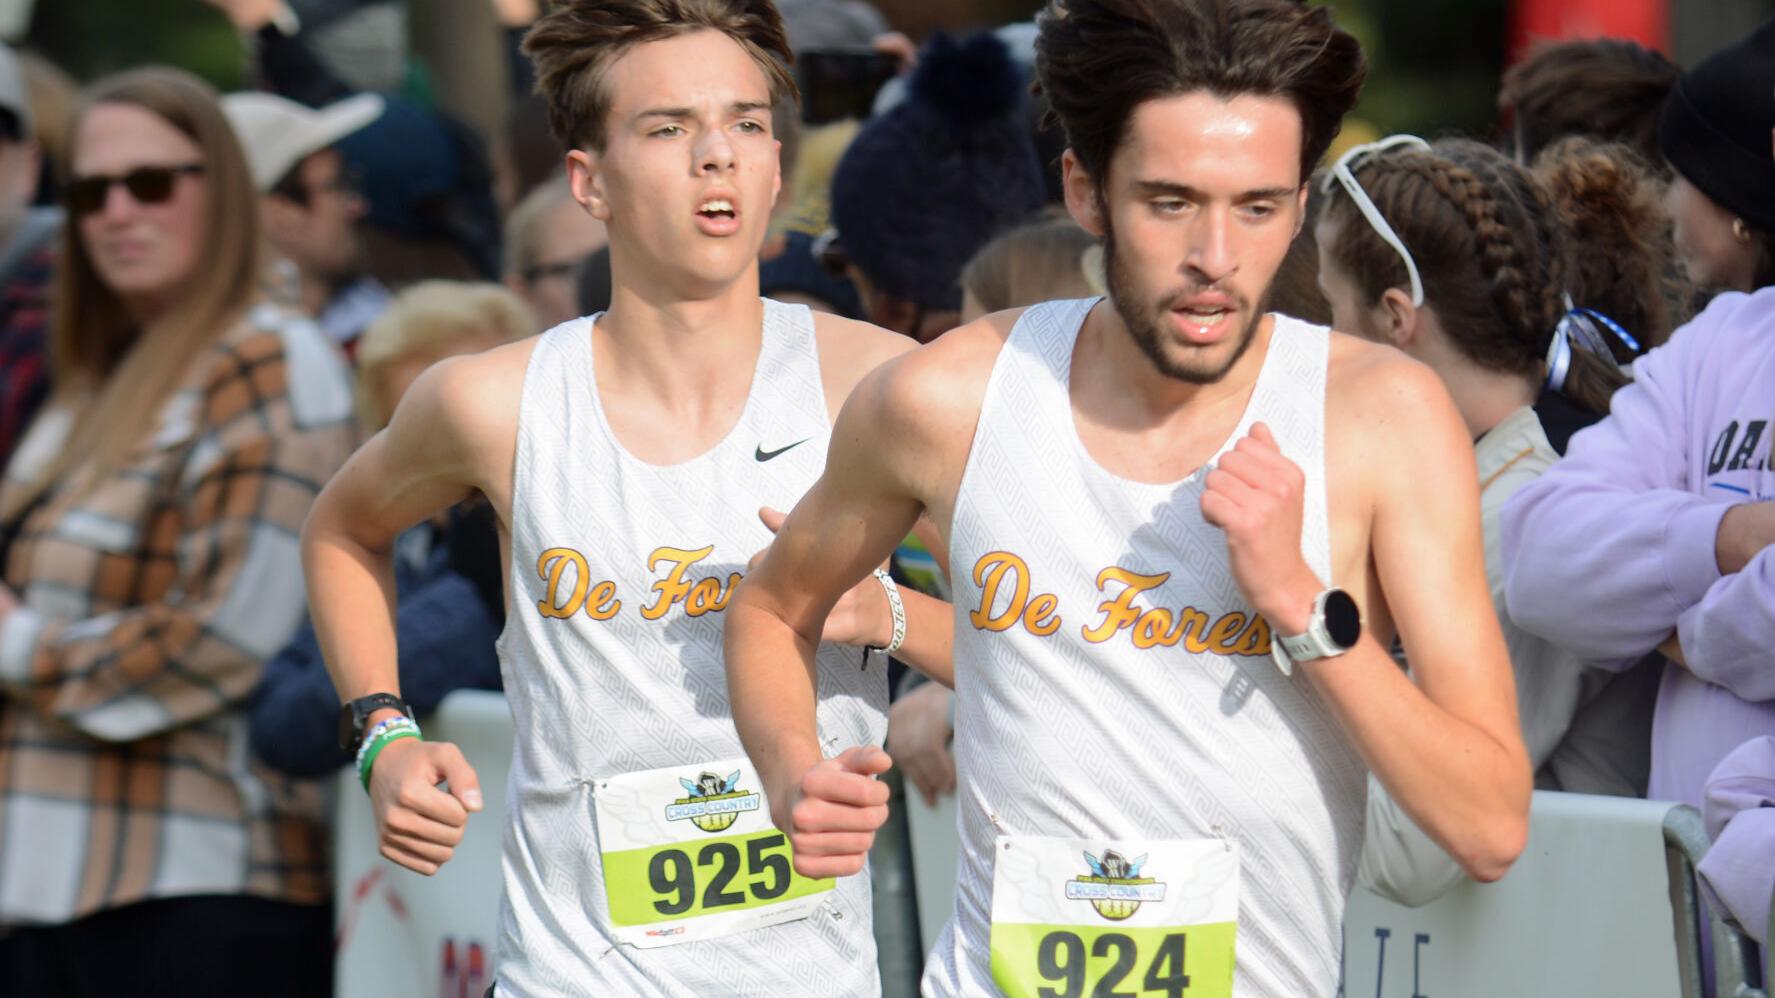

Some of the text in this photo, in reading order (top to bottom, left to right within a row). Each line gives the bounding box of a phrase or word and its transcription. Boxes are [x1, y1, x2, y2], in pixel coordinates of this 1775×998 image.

[537, 547, 621, 620] De
[970, 551, 1271, 656] De Fores
[669, 799, 757, 818] CROSS COUNTRY
[648, 833, 791, 916] 925
[1037, 931, 1190, 998] 924
